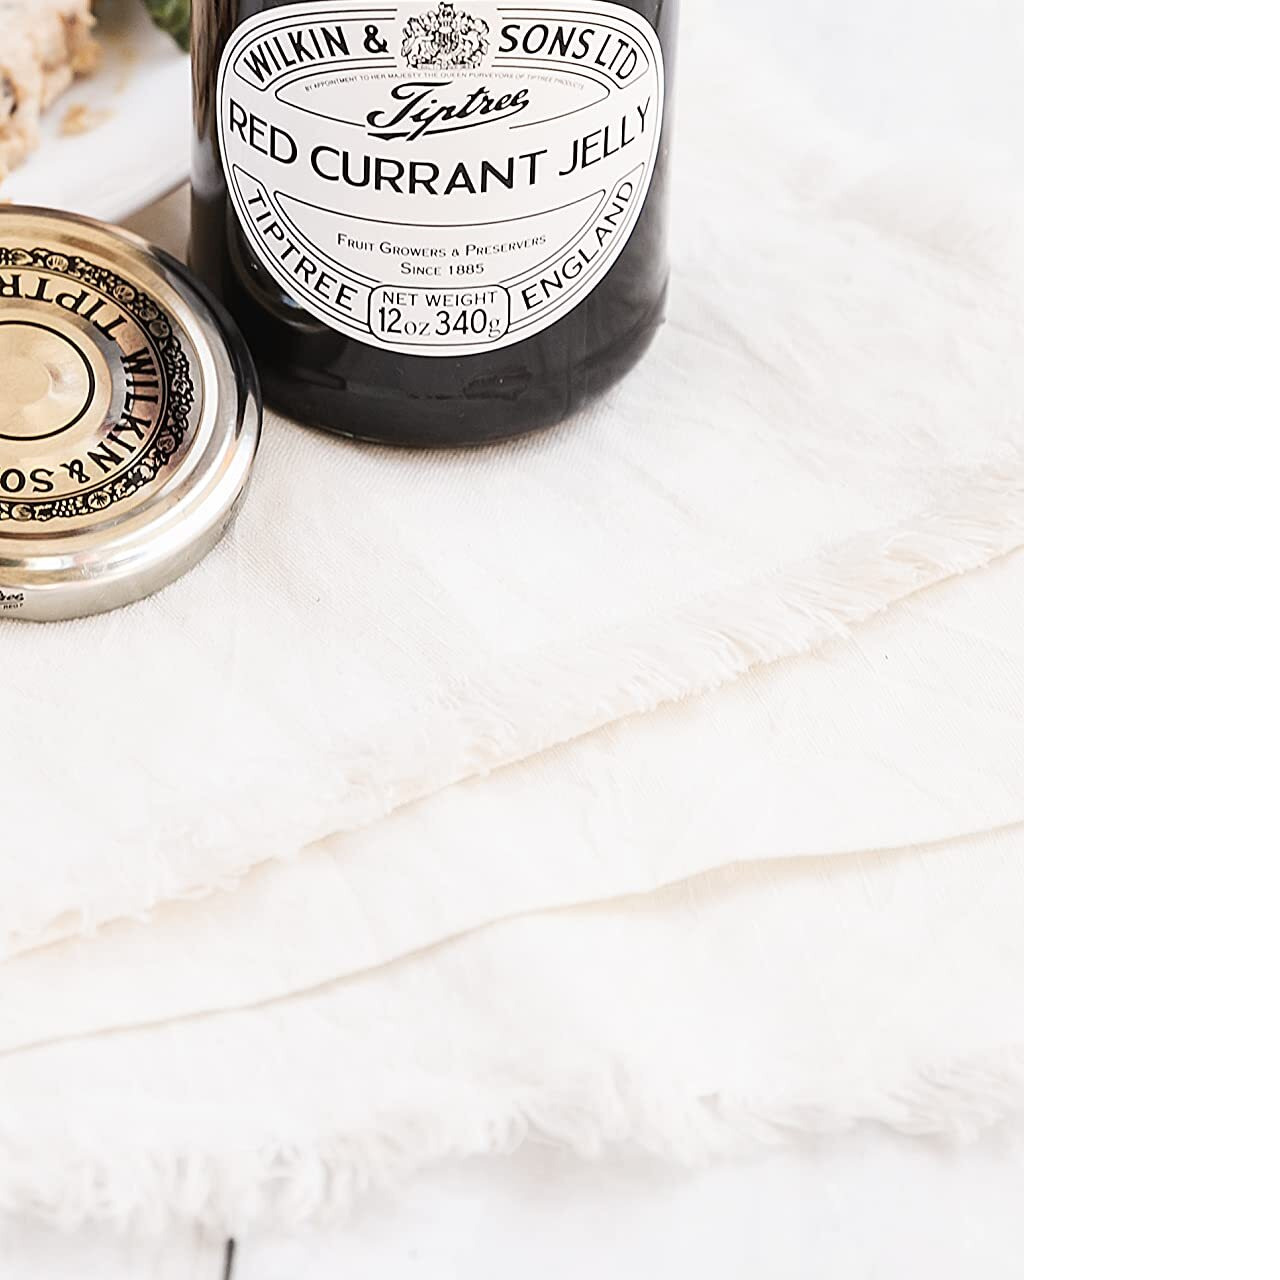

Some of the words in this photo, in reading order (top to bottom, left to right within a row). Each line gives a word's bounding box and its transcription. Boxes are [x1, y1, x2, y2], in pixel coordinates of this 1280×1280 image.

[243, 24, 350, 84] WILKIN
[363, 24, 389, 54] &
[498, 23, 589, 59] SONS
[593, 34, 638, 80] LTD
[314, 76, 357, 89] APPOINTMENT
[366, 81, 530, 141] Tiptree
[230, 98, 298, 165] RED
[311, 145, 548, 195] CURRANT
[558, 97, 652, 177] JELLY
[246, 188, 359, 312] TIPTREE
[448, 263, 485, 276] 1885
[522, 181, 634, 311] ENGLAND
[378, 307, 431, 337] 12oz
[435, 308, 501, 338] 340g
[382, 291, 419, 307] NET
[425, 290, 499, 308] WEIGHT
[94, 346, 161, 480] WILKIN
[67, 460, 92, 484] &
